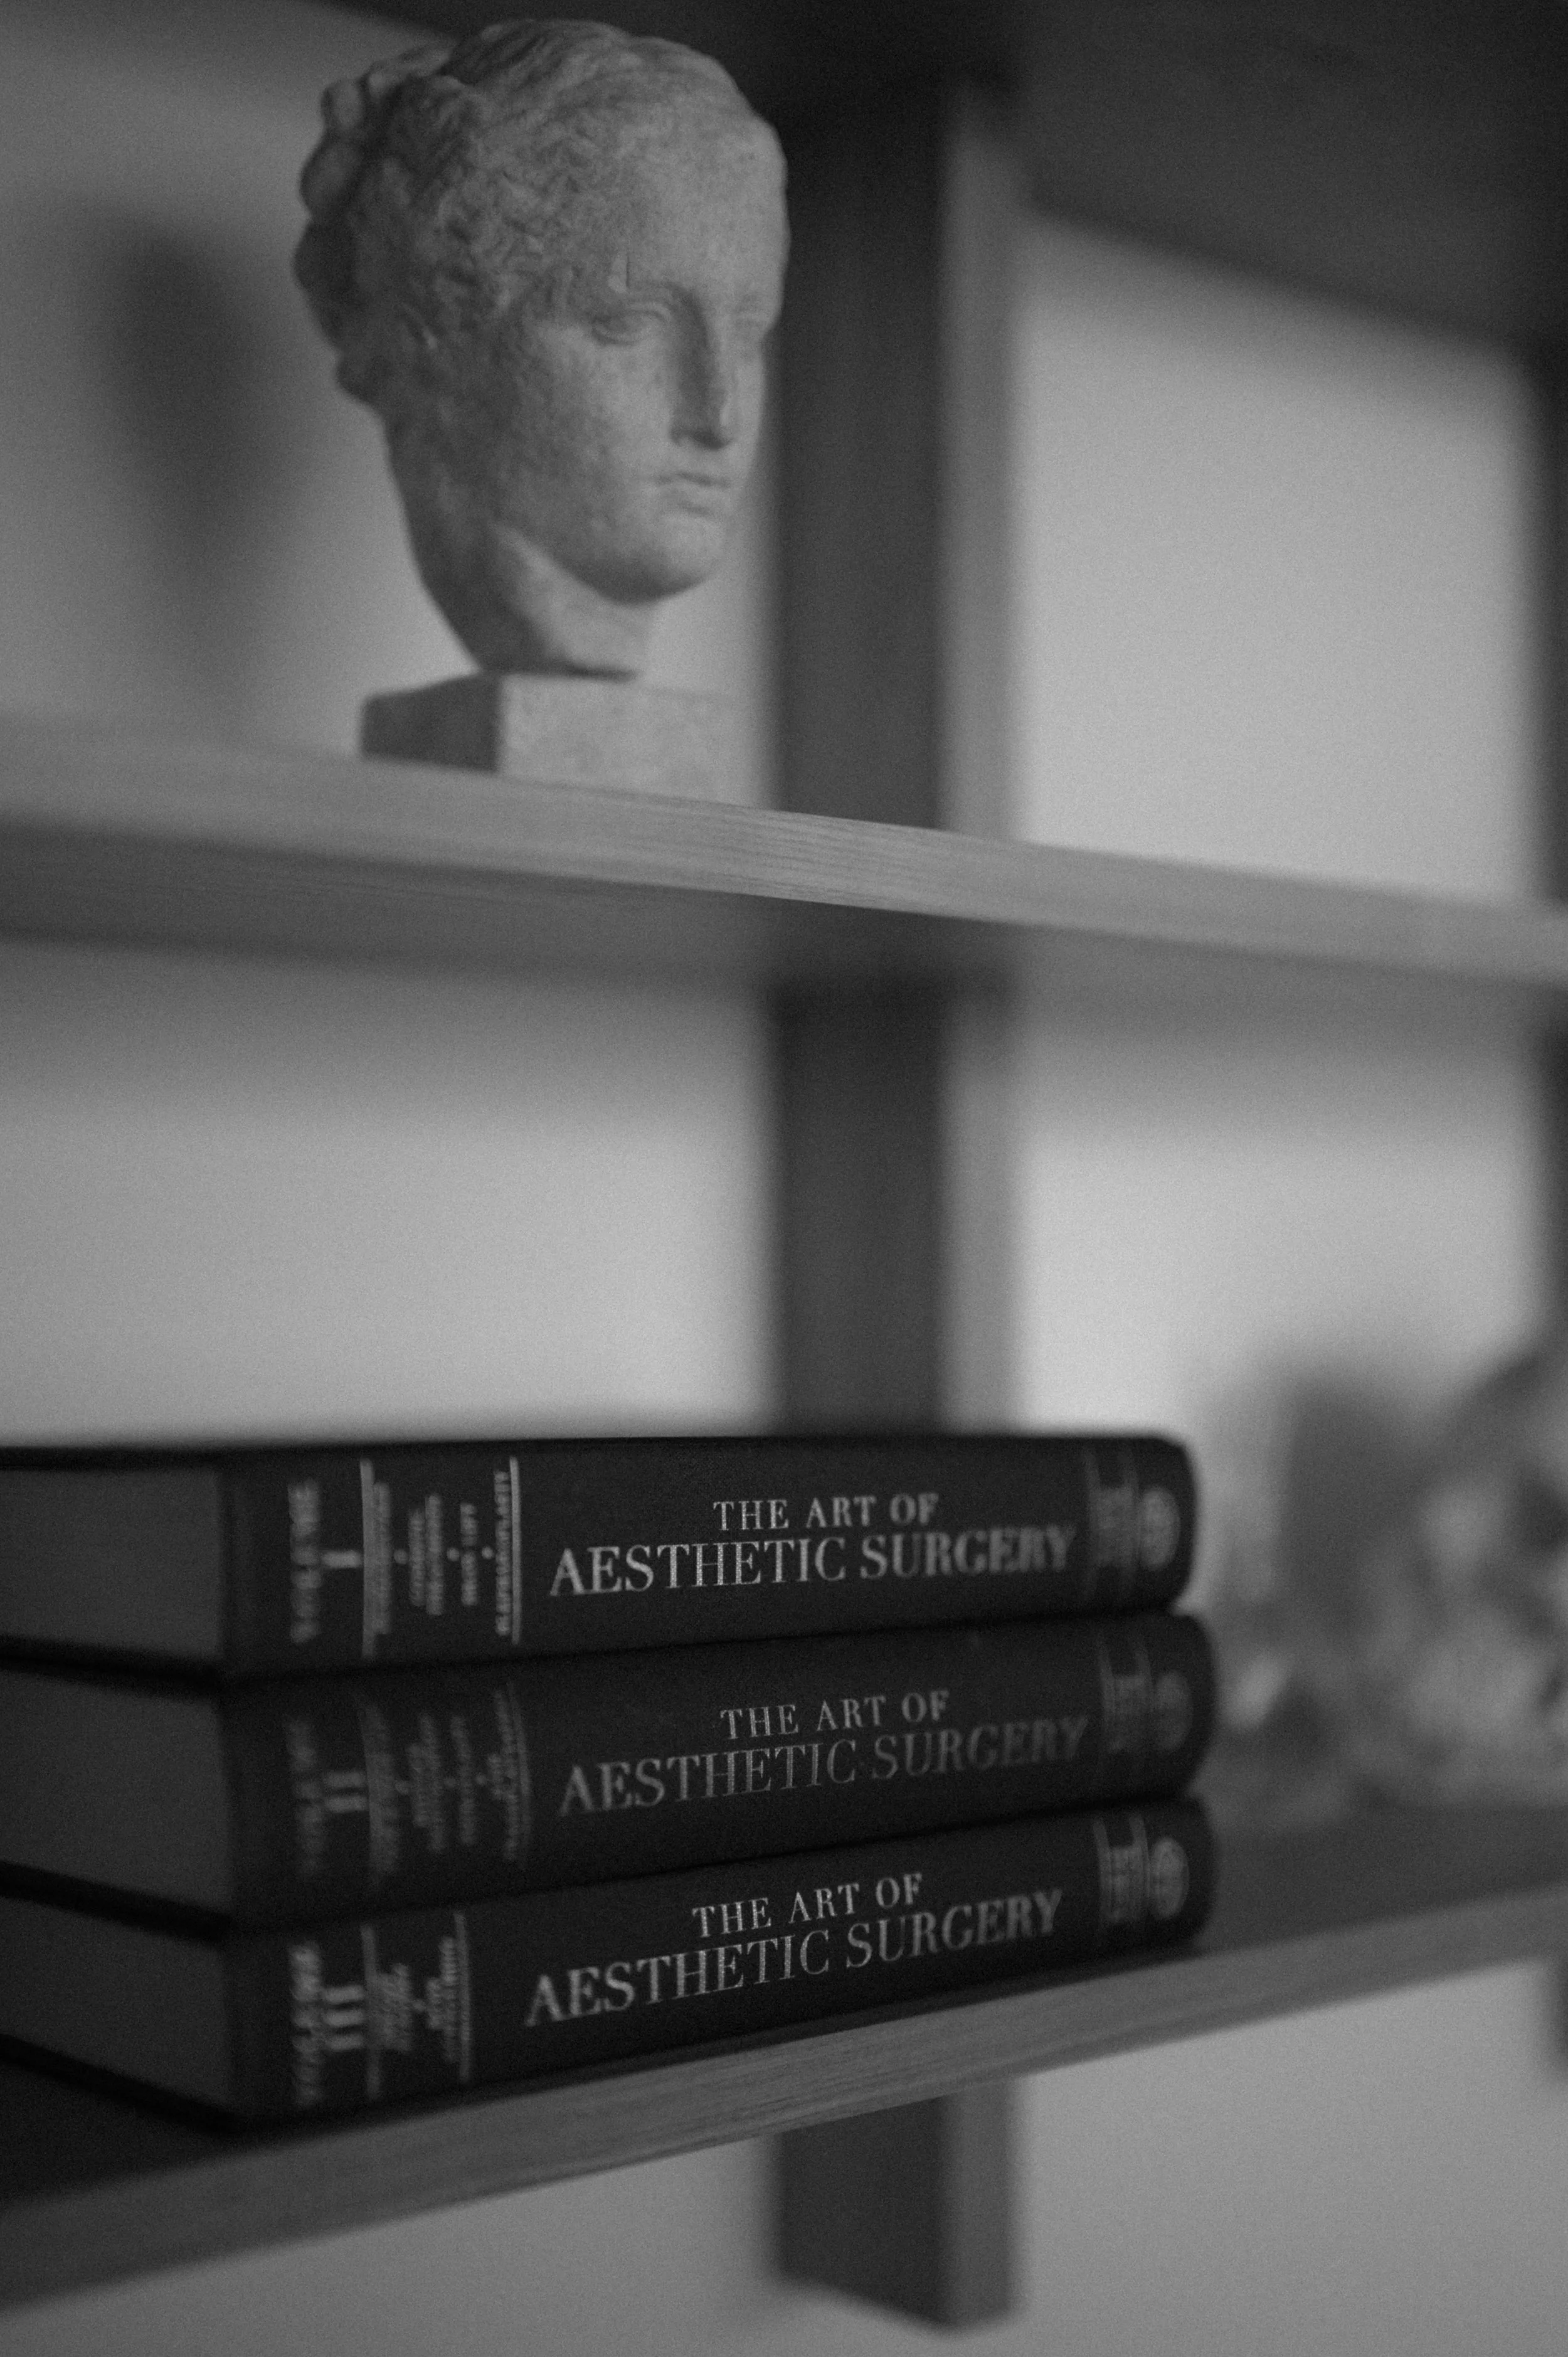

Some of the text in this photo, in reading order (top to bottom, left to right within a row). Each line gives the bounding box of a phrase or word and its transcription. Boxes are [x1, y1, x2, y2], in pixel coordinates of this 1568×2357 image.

[712, 1492, 940, 1531] THE ART OF
[550, 1536, 847, 1596] AESTHETIC
[859, 1525, 1074, 1580] SURGERY
[719, 1689, 950, 1740] THE ART OF
[560, 1740, 857, 1816] AESTHETIC
[872, 1716, 1089, 1779] SURGERY
[692, 1873, 924, 1937] THE ART OF
[525, 1930, 830, 2026] AESTHETIC
[846, 1888, 1063, 1969] SURGERY
